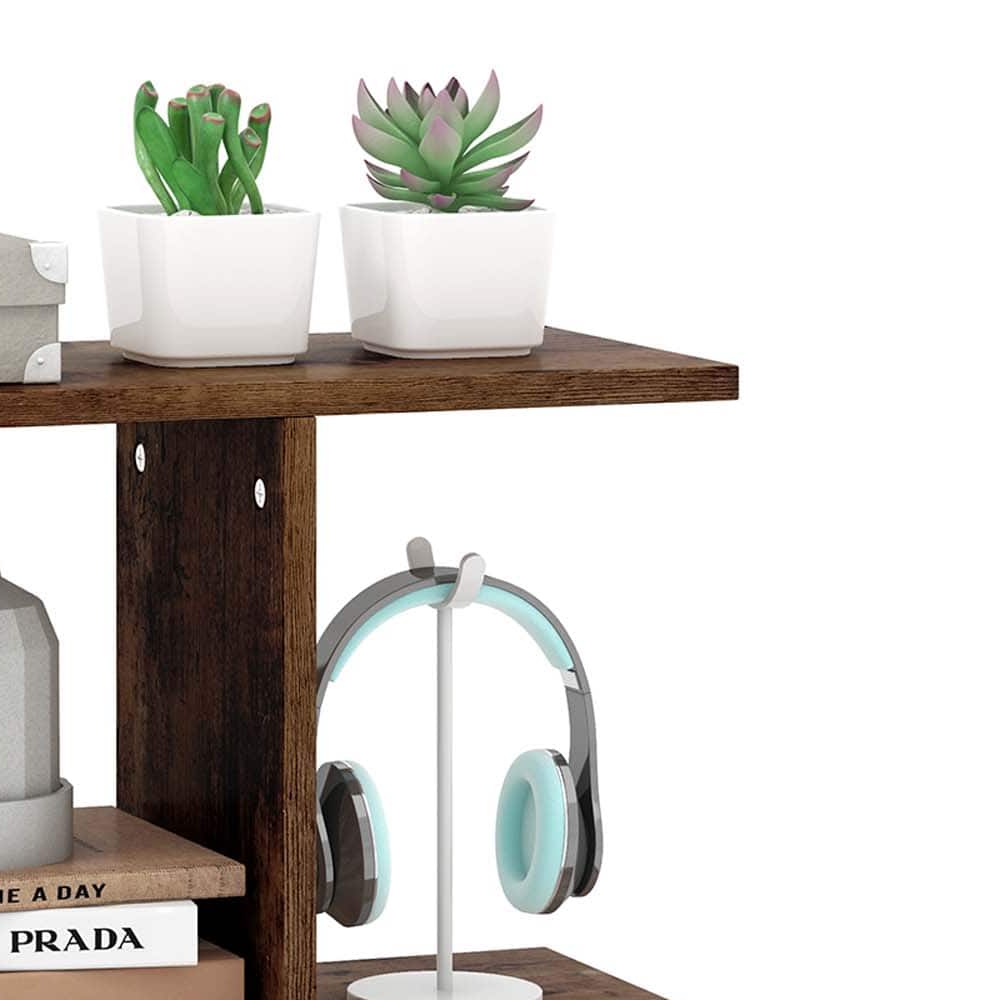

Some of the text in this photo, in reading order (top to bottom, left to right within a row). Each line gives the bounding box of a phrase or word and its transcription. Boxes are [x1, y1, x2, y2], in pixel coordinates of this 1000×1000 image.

[31, 886, 47, 902] A
[56, 882, 107, 900] DAY
[10, 927, 144, 953] PRADA
